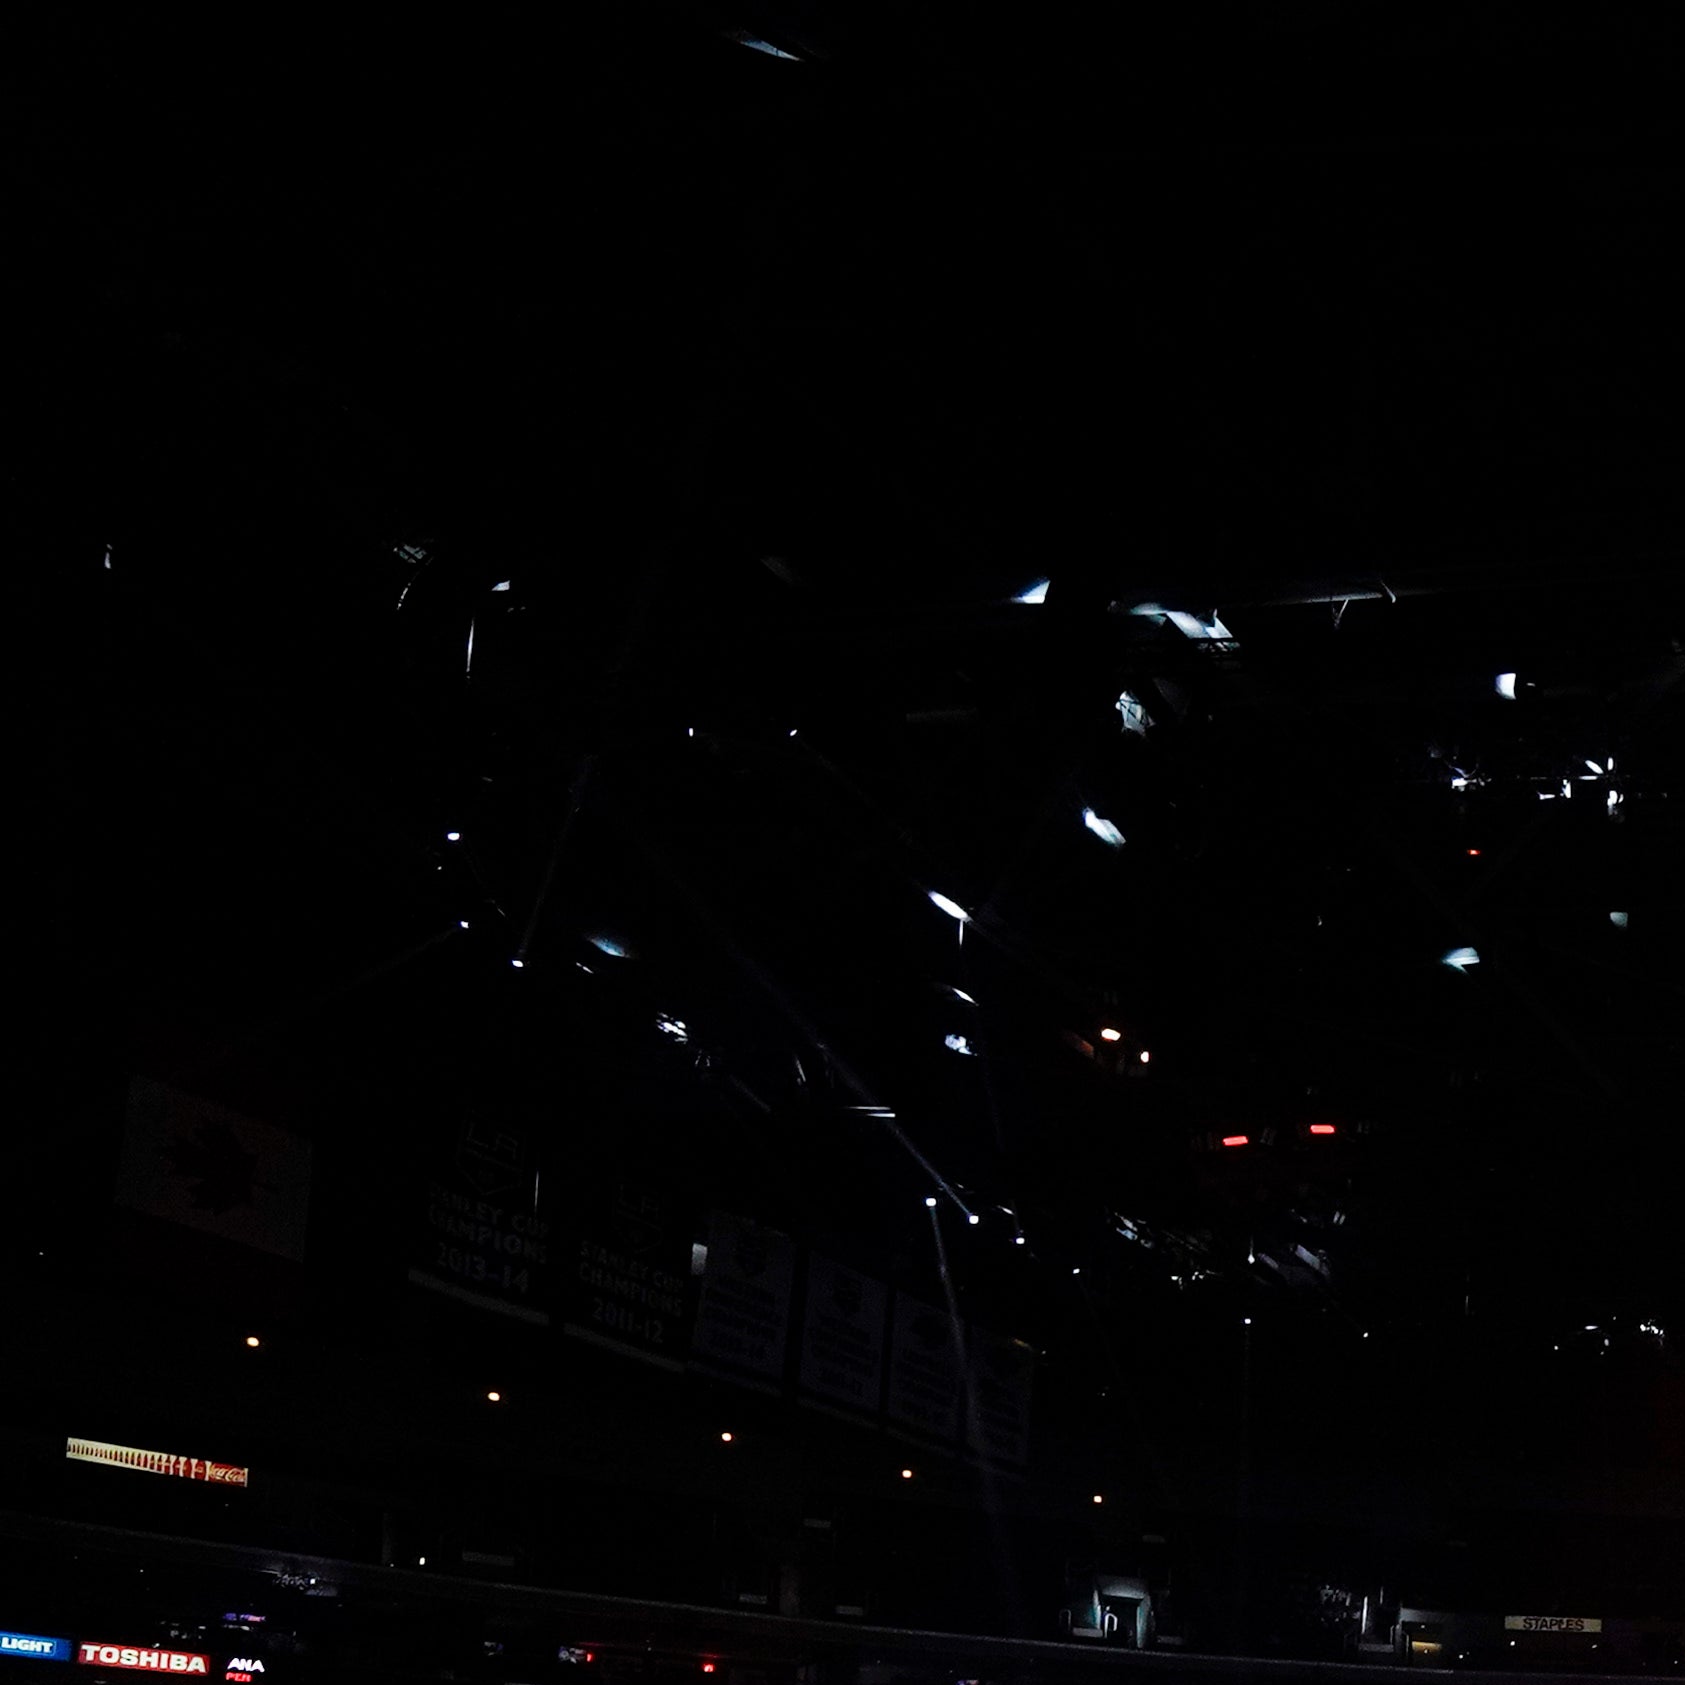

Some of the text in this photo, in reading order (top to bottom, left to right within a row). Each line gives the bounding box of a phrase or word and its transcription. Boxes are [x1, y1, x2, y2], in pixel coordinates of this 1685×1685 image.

[1523, 1617, 1584, 1630] STAPLES
[1, 1636, 53, 1656] LIGHT
[81, 1643, 207, 1674] TOSHIBA
[227, 1657, 265, 1673] ANA
